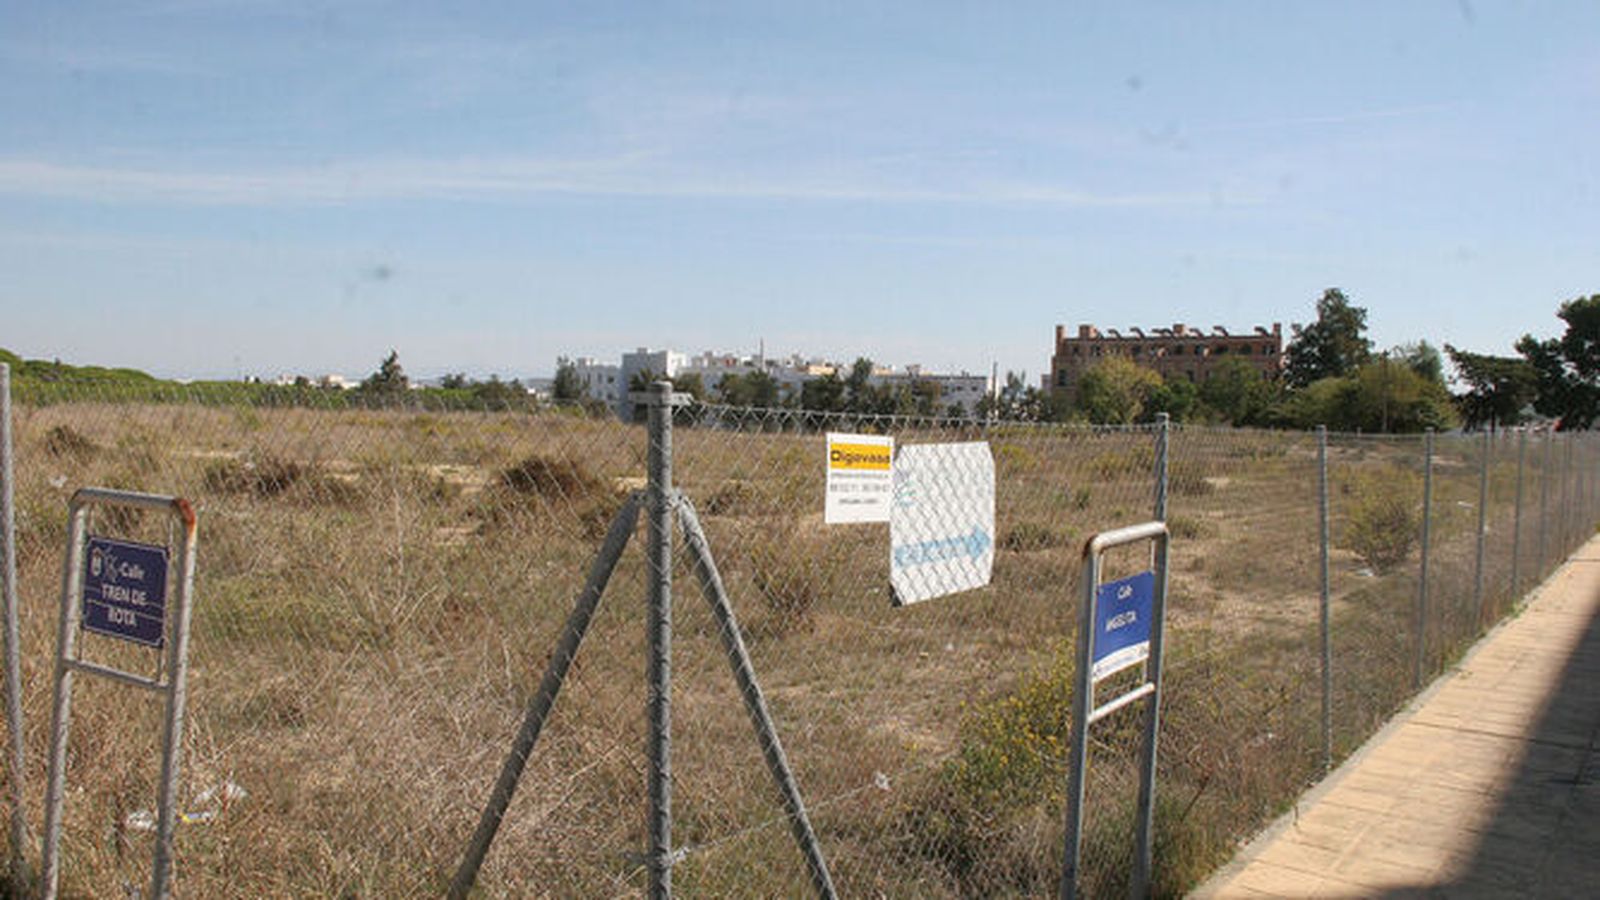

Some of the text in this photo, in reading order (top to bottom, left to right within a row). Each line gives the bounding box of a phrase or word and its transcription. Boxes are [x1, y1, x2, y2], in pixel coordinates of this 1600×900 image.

[101, 584, 147, 605] TREN DE
[107, 606, 136, 626] ROTA
